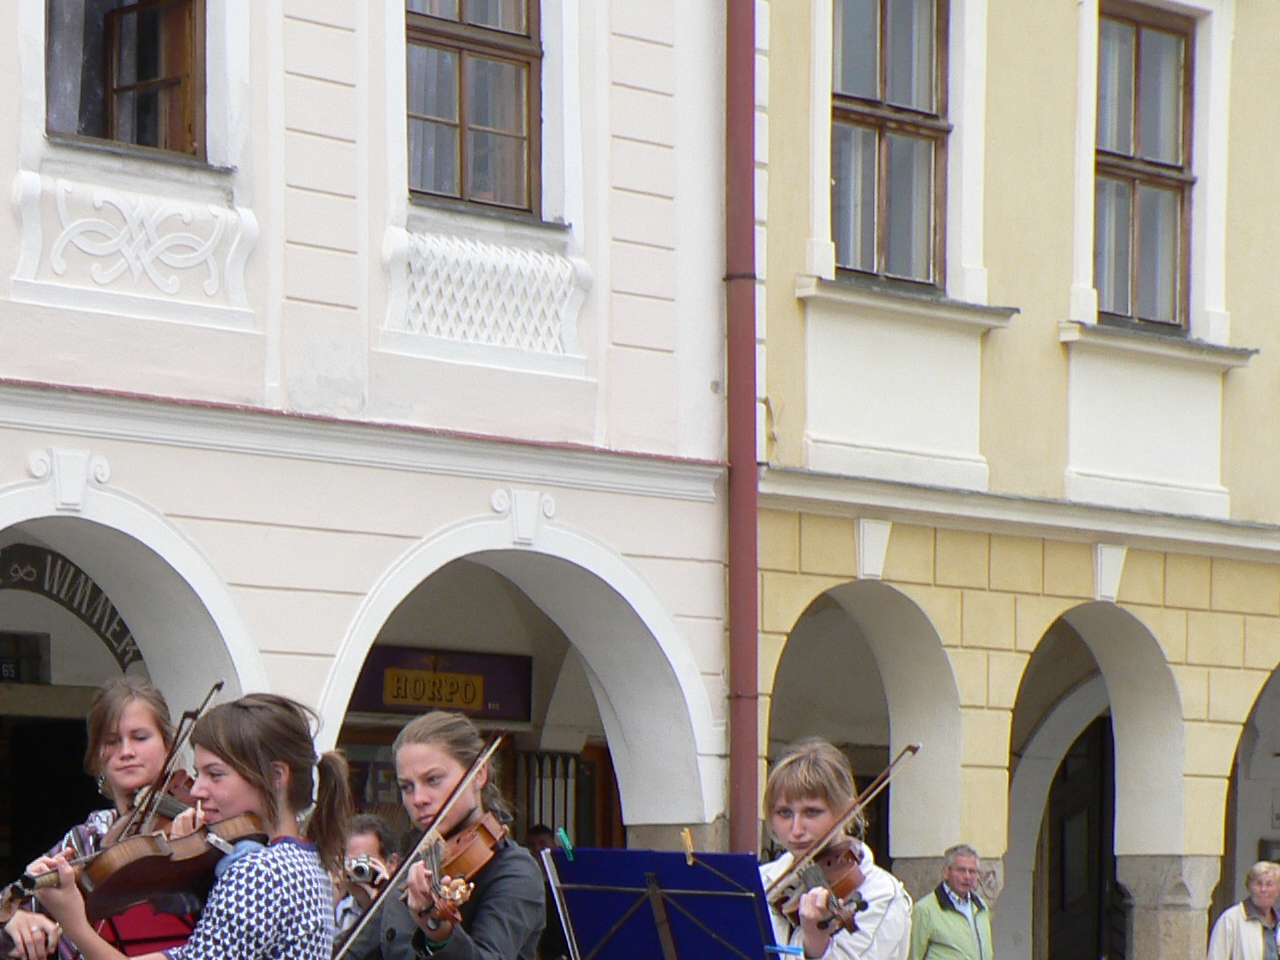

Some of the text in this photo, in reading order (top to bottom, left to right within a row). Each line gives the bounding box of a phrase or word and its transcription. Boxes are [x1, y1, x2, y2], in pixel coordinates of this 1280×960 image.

[43, 553, 139, 664] WIMMER
[1, 663, 16, 678] 65
[390, 673, 477, 705] HORPO
